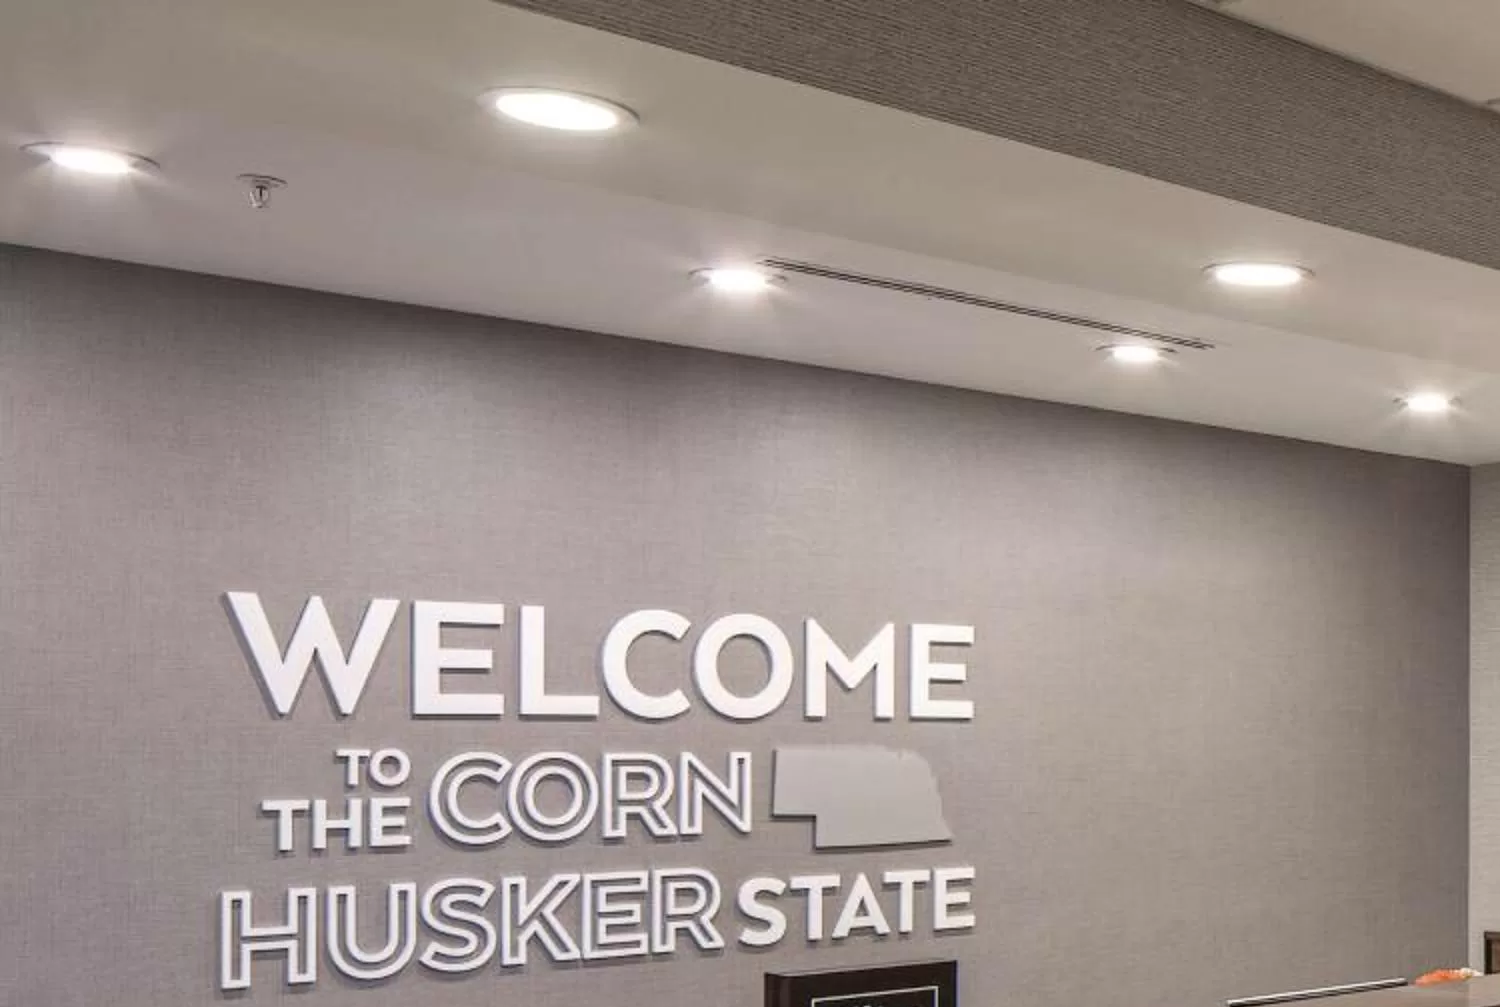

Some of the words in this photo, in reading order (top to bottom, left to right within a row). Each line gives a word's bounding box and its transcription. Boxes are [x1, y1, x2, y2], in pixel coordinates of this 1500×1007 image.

[226, 590, 976, 720] WELCOME
[262, 796, 411, 852] THE
[429, 751, 752, 846] CORN
[335, 748, 411, 789] TO
[220, 866, 725, 991] HUSKER
[738, 866, 976, 947] STATE
